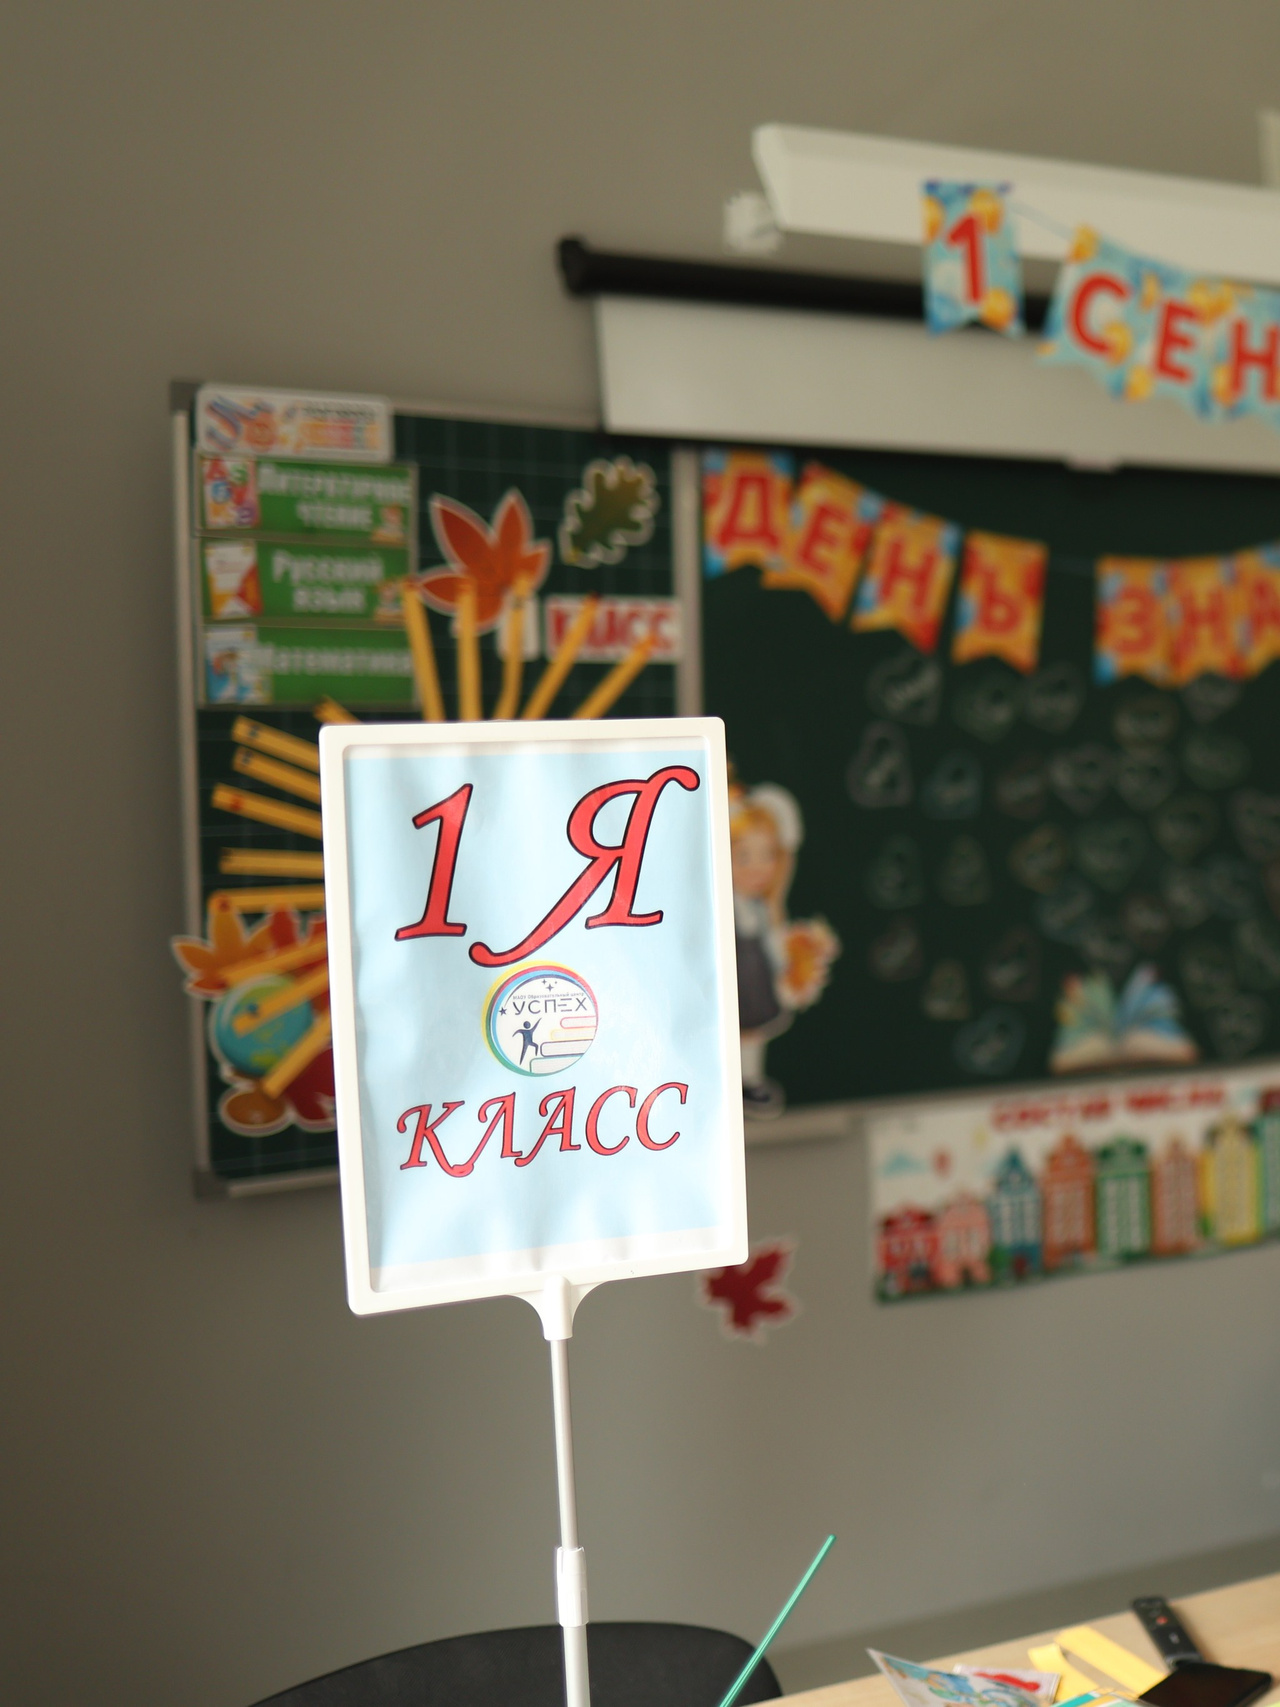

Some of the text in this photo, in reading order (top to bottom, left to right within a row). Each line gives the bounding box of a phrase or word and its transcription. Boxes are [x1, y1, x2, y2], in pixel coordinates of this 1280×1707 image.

[946, 212, 987, 304] 1
[717, 472, 1023, 635] ДЕНЬ
[394, 765, 700, 968] 1 Я
[512, 997, 588, 1016] УСПЕХ
[397, 1082, 688, 1179] КЛАСС
